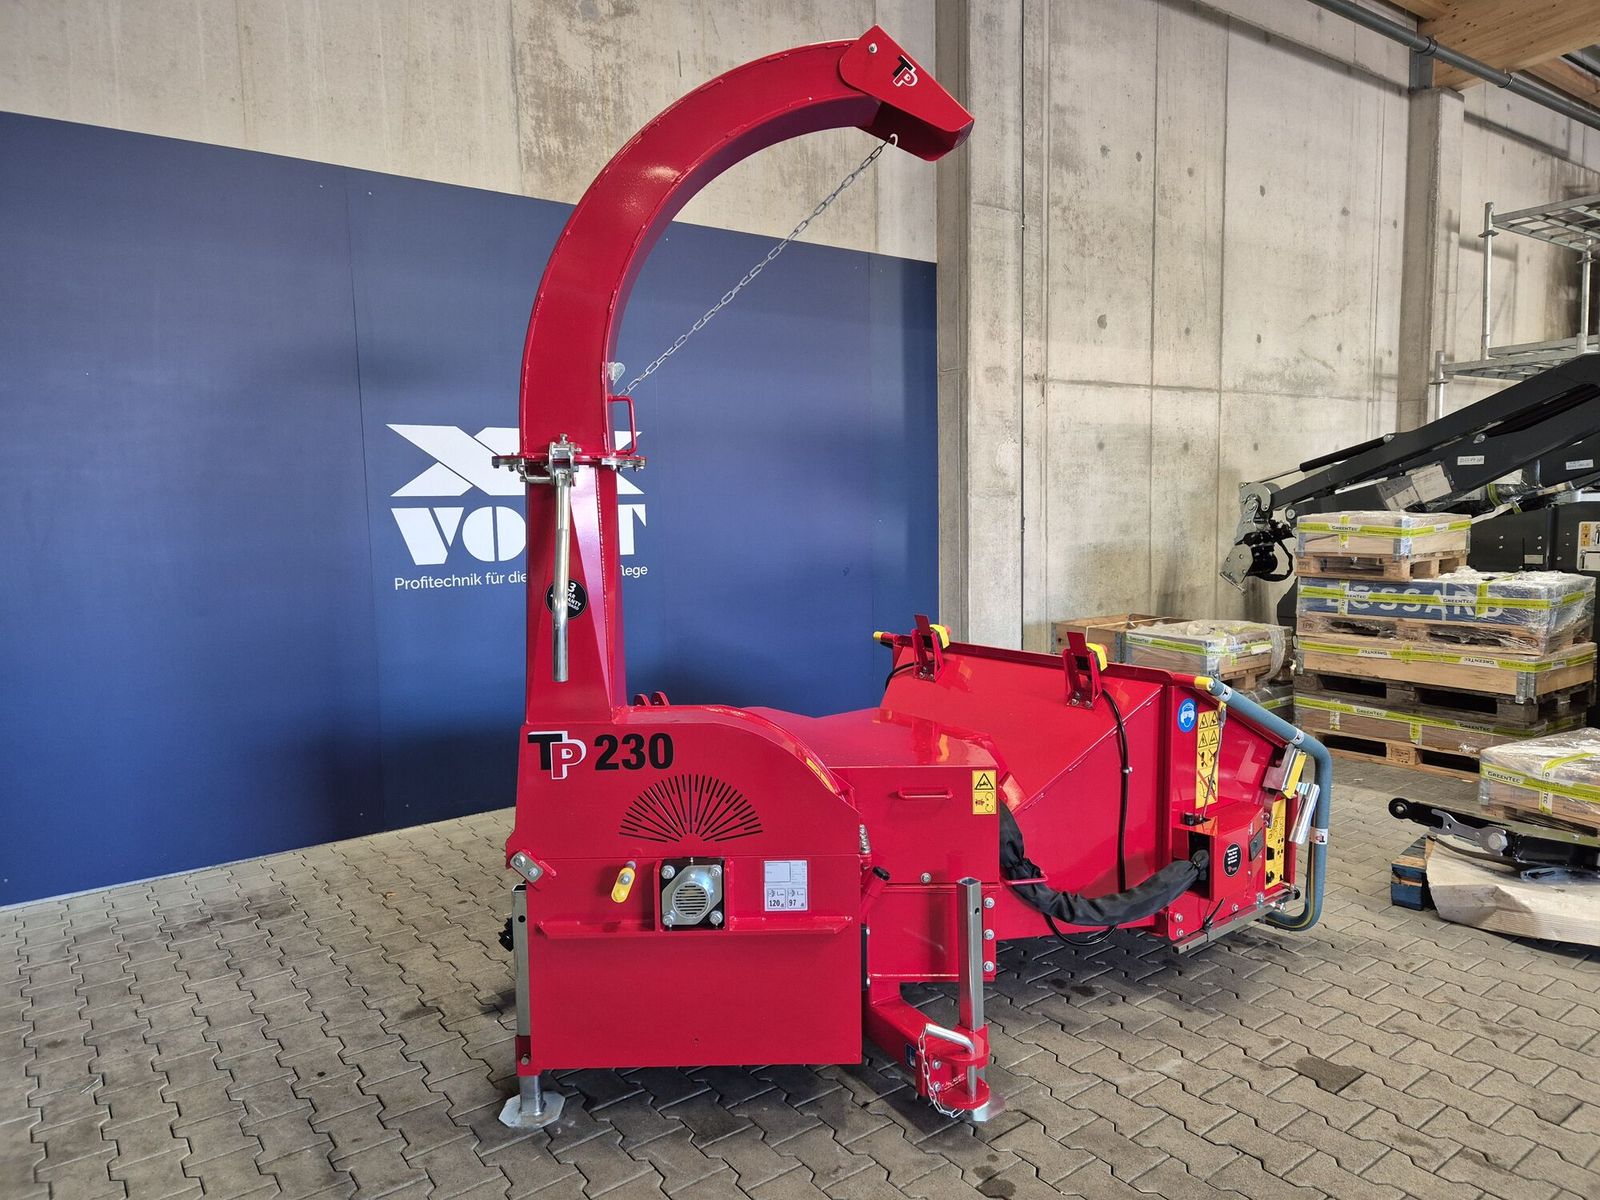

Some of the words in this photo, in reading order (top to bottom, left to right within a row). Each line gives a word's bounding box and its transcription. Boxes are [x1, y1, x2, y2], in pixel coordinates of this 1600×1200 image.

[892, 54, 918, 87] TP
[394, 573, 482, 590] Profitechnik
[485, 571, 505, 585] für
[508, 570, 527, 584] die
[527, 731, 587, 780] TP
[594, 733, 674, 771] 230
[769, 899, 780, 907] 120
[789, 899, 797, 907] 97
